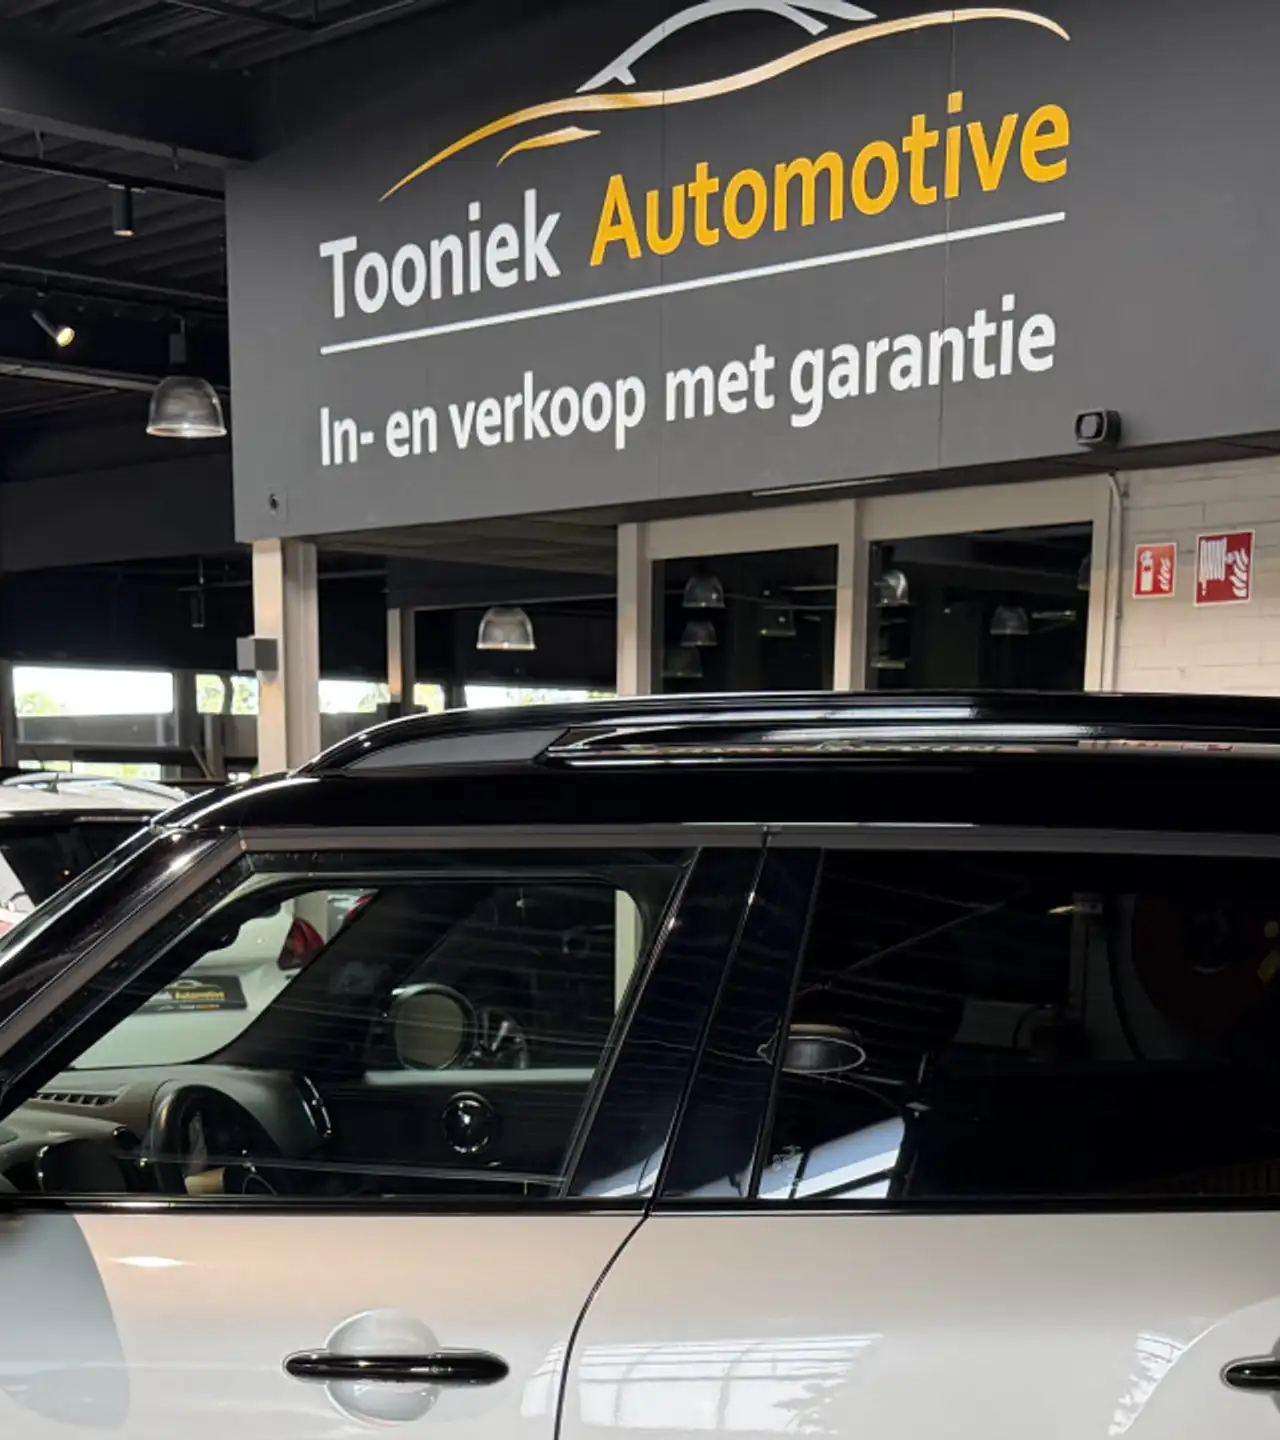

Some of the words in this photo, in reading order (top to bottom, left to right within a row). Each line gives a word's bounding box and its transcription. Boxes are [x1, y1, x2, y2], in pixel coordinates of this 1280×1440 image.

[319, 188, 561, 319] Tooniek
[589, 90, 1070, 267] Automotive
[319, 406, 375, 467] In-
[385, 406, 438, 458] en
[447, 370, 647, 451] verkoop
[665, 344, 776, 423] met
[789, 293, 1057, 429] garantie
